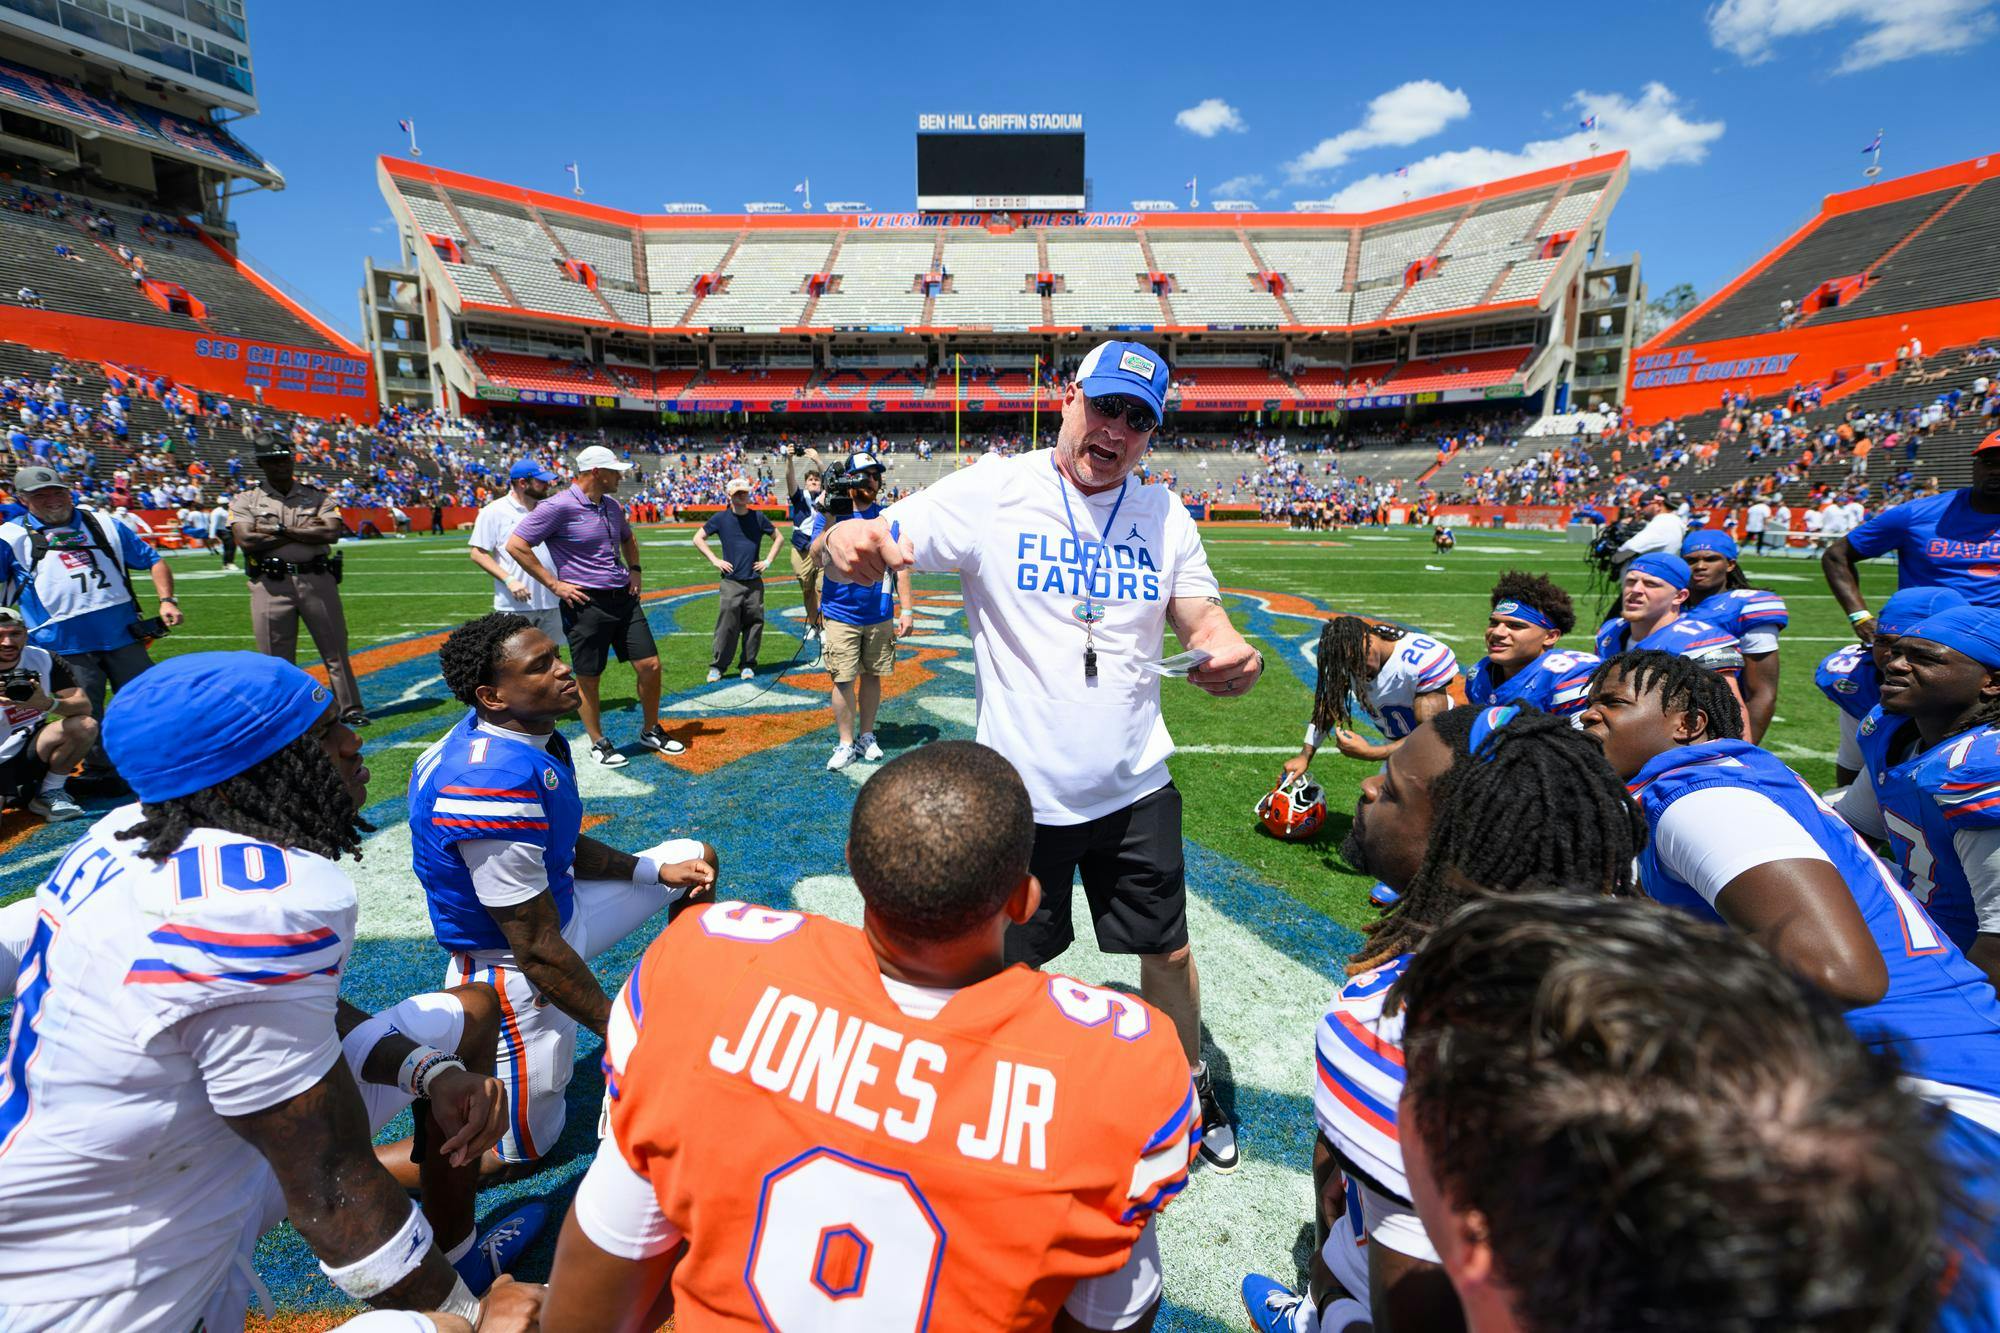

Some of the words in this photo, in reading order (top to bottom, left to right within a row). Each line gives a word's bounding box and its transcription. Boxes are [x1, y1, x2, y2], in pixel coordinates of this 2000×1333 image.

[919, 113, 946, 129] BEN
[948, 113, 976, 129] HILL
[978, 113, 1027, 129] GRIFFIN
[1029, 113, 1083, 129] STADIUM
[857, 213, 953, 227] WELCOME
[959, 213, 982, 227] TO
[1021, 213, 1055, 227] THE
[1058, 213, 1140, 227] SWAMP
[195, 338, 239, 359] SEC
[247, 345, 368, 376] CHAMPIONS
[1635, 352, 1673, 371] THIS
[1631, 365, 1693, 389] GATOR
[1694, 353, 1799, 382] COUNTRY
[801, 401, 825, 409] ALMA
[900, 401, 923, 409] ALMA
[998, 401, 1022, 409] ALMA
[1195, 401, 1218, 409] ALMA
[1018, 532, 1157, 573] FLORIDA
[70, 569, 112, 594] 72
[1017, 563, 1160, 601] GATORS
[1401, 637, 1436, 665] 20
[468, 737, 491, 764] 1
[164, 842, 291, 905] 10
[1047, 974, 1151, 1042] 9
[708, 985, 948, 1143] JONES
[955, 1060, 1057, 1171] JR
